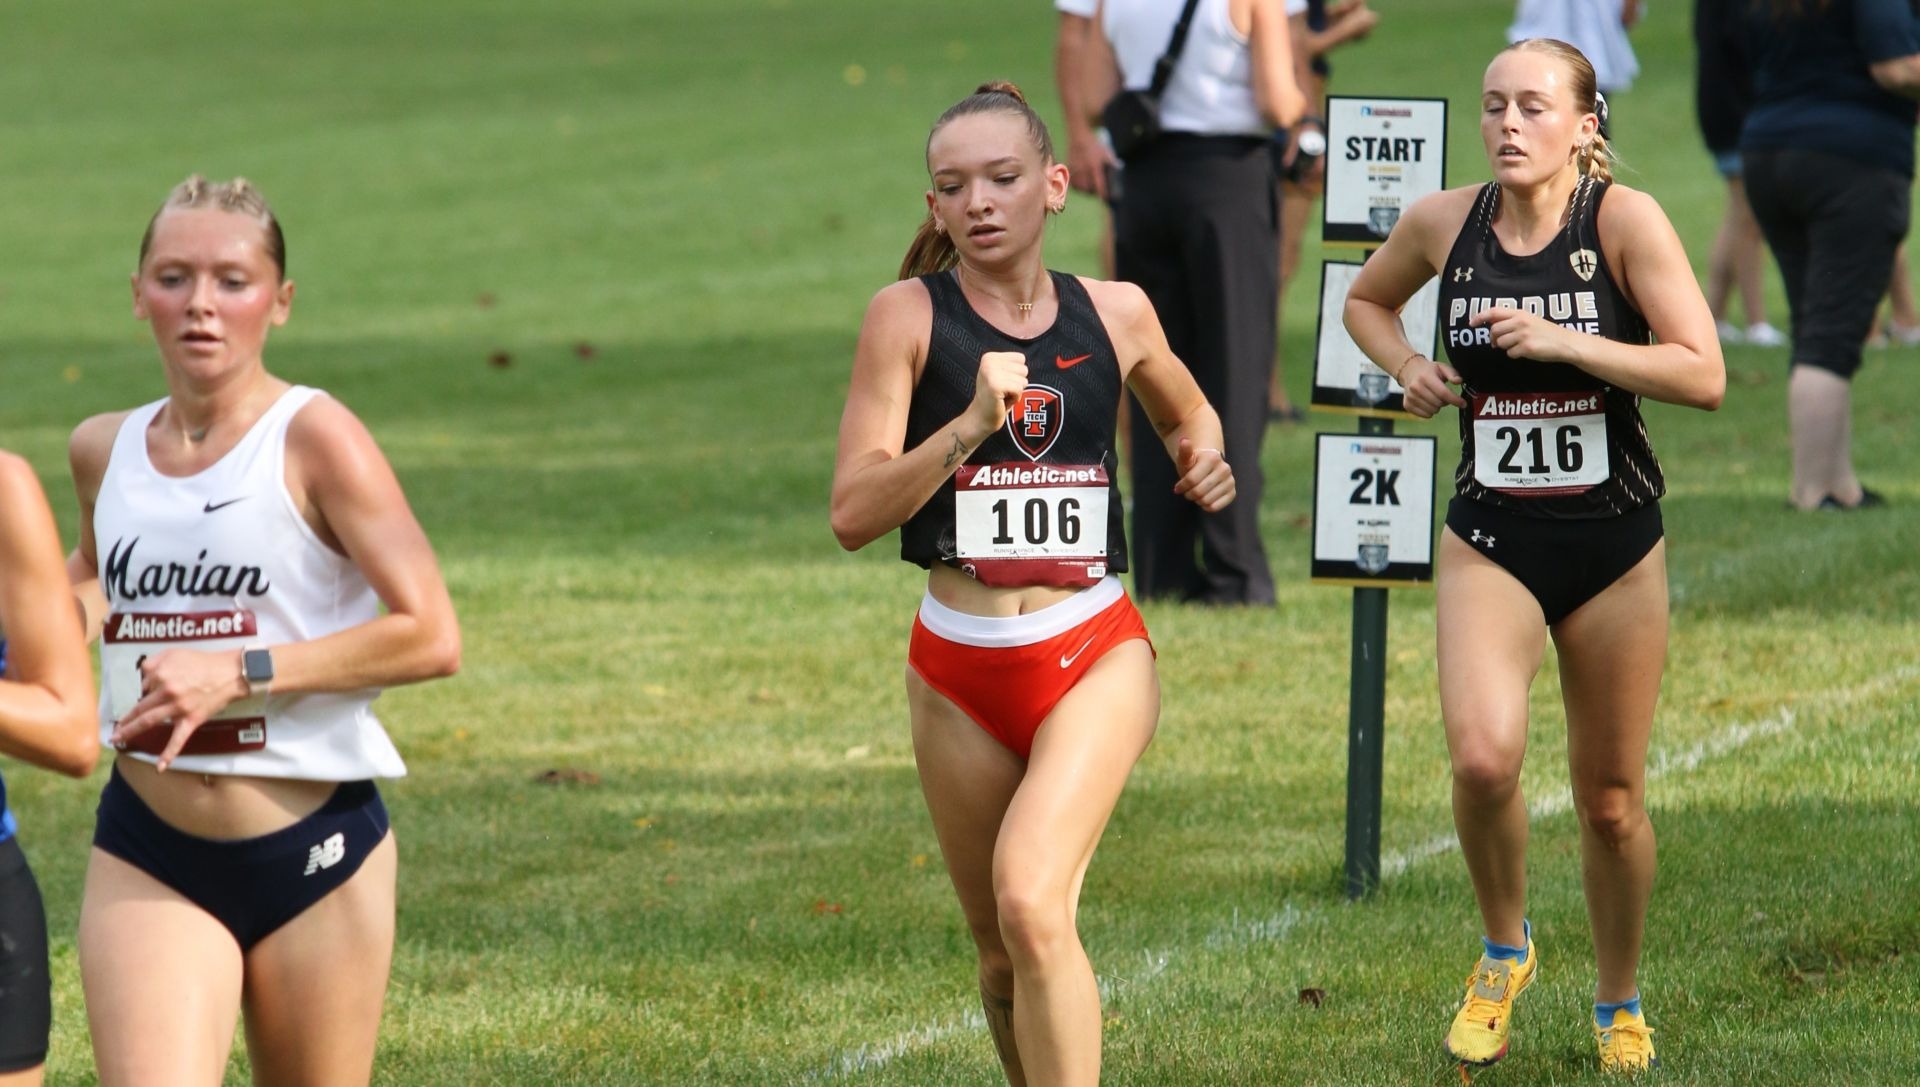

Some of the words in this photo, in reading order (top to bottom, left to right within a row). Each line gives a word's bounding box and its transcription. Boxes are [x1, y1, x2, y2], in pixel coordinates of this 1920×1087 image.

[1346, 136, 1426, 162] START
[1450, 327, 1491, 347] FOR
[1026, 413, 1045, 421] TECH
[1480, 395, 1598, 416] Athletic.net
[1496, 425, 1583, 474] 216
[969, 466, 1097, 487] Athletic.net
[1349, 468, 1401, 506] 2K
[992, 498, 1081, 545] 106
[105, 535, 270, 602] Marian
[116, 612, 244, 640] Athletic.net
[303, 831, 345, 876] NB
